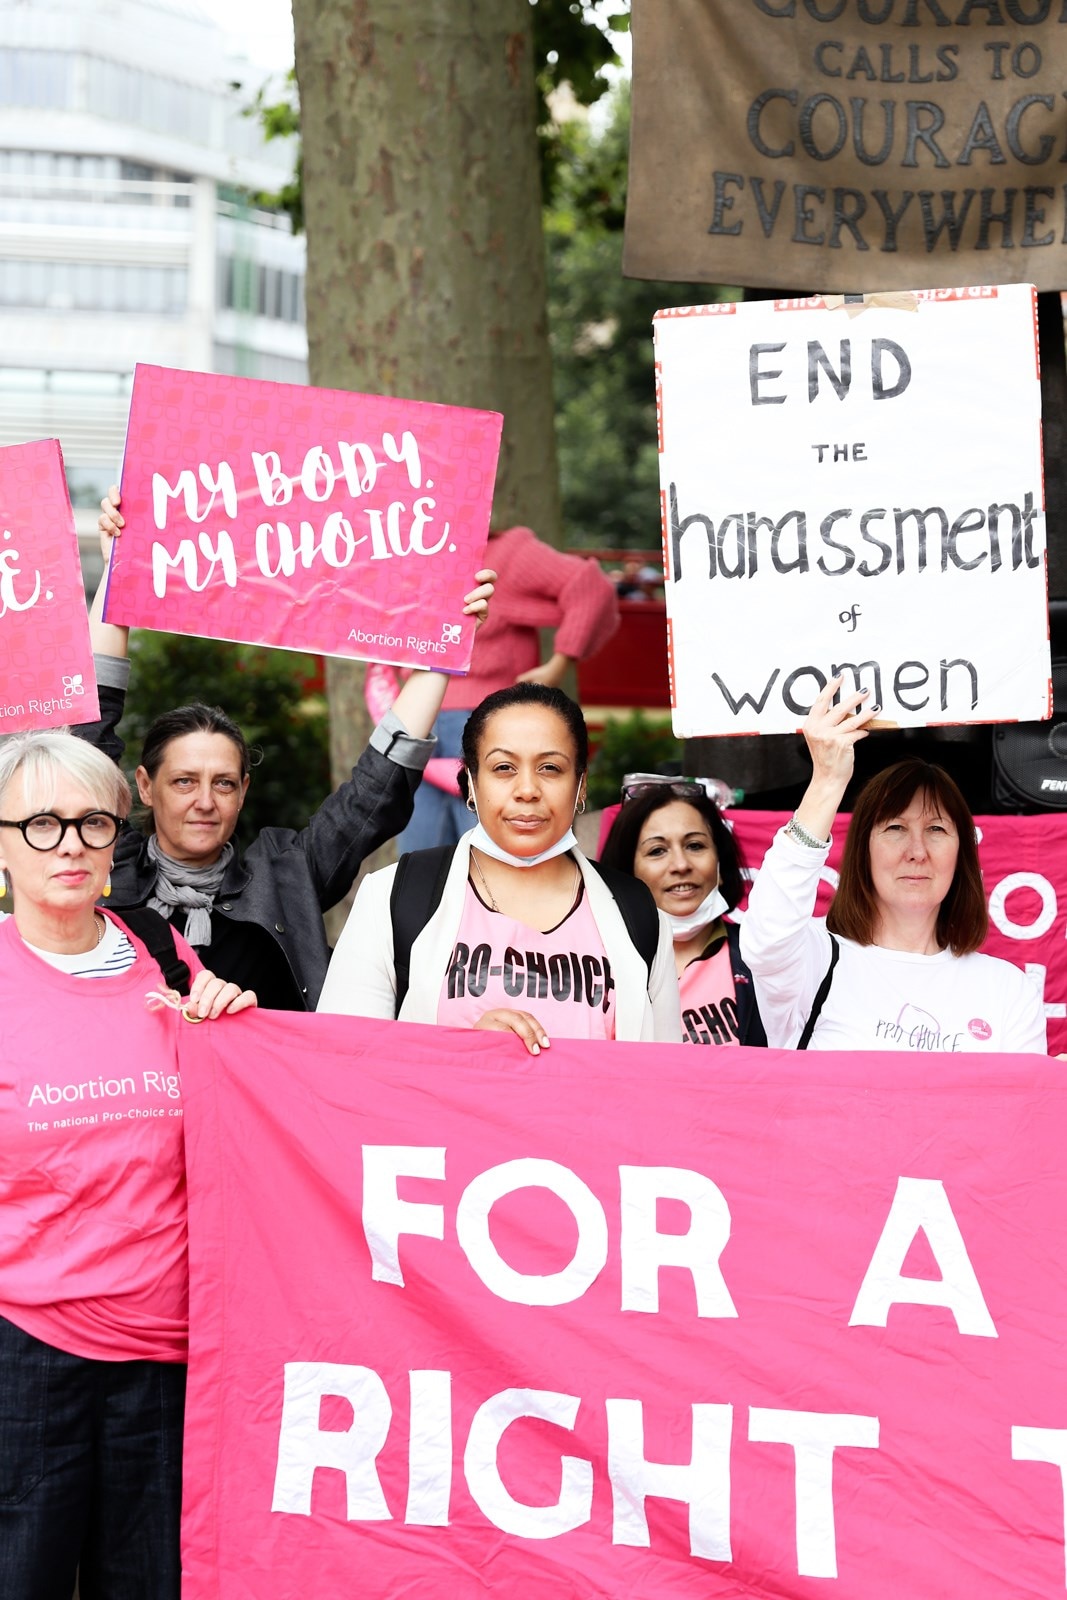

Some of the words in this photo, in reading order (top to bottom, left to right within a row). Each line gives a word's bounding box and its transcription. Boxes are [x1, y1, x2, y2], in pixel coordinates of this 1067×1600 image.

[813, 40, 959, 82] CALLS
[984, 41, 1042, 80] TO
[747, 88, 1067, 168] COURAG
[707, 170, 1067, 252] EVERYWHE
[748, 337, 912, 406] END
[152, 461, 238, 530] MY
[252, 431, 435, 506] BODY.
[811, 442, 868, 463] THE
[152, 530, 238, 598] MY
[255, 497, 457, 578] CHOICE.
[670, 482, 1041, 583] harassment
[347, 628, 403, 648] Abortion
[406, 636, 447, 655] Rights
[839, 603, 862, 632] of
[28, 697, 73, 715] Rights
[711, 659, 979, 716] women
[28, 1076, 136, 1107] Abortion
[142, 1070, 182, 1099] Rig
[28, 1121, 49, 1132] The
[53, 1113, 98, 1129] national
[102, 1107, 165, 1123] Pro-Choice
[361, 1144, 739, 1318] FOR
[848, 1176, 999, 1338] A
[271, 1361, 880, 1579] RIGHT
